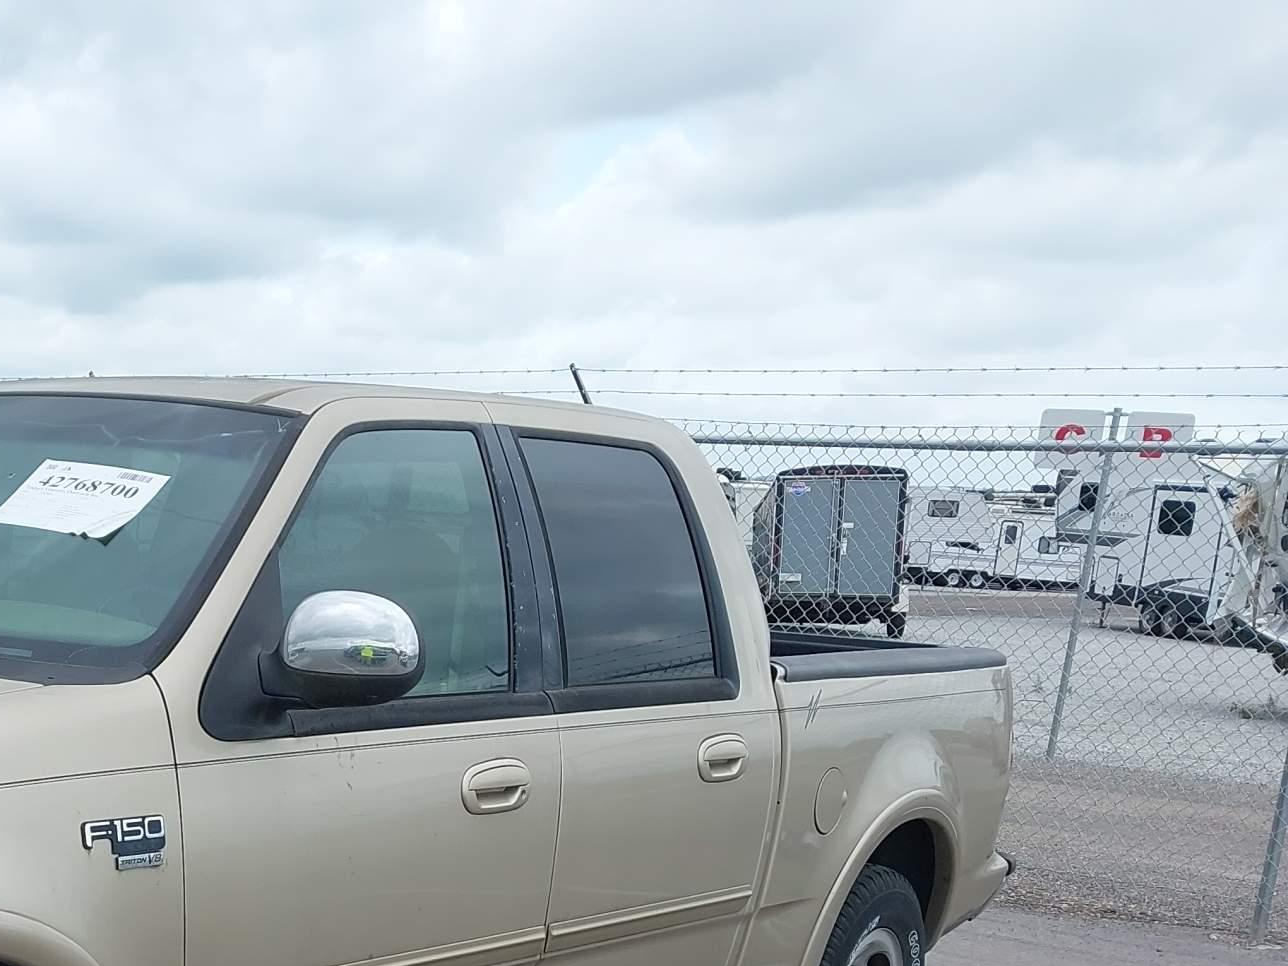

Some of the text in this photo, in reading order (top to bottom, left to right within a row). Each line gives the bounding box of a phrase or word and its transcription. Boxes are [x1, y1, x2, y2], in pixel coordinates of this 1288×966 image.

[39, 474, 140, 499] 42768700
[119, 853, 162, 866] TRITON V8
